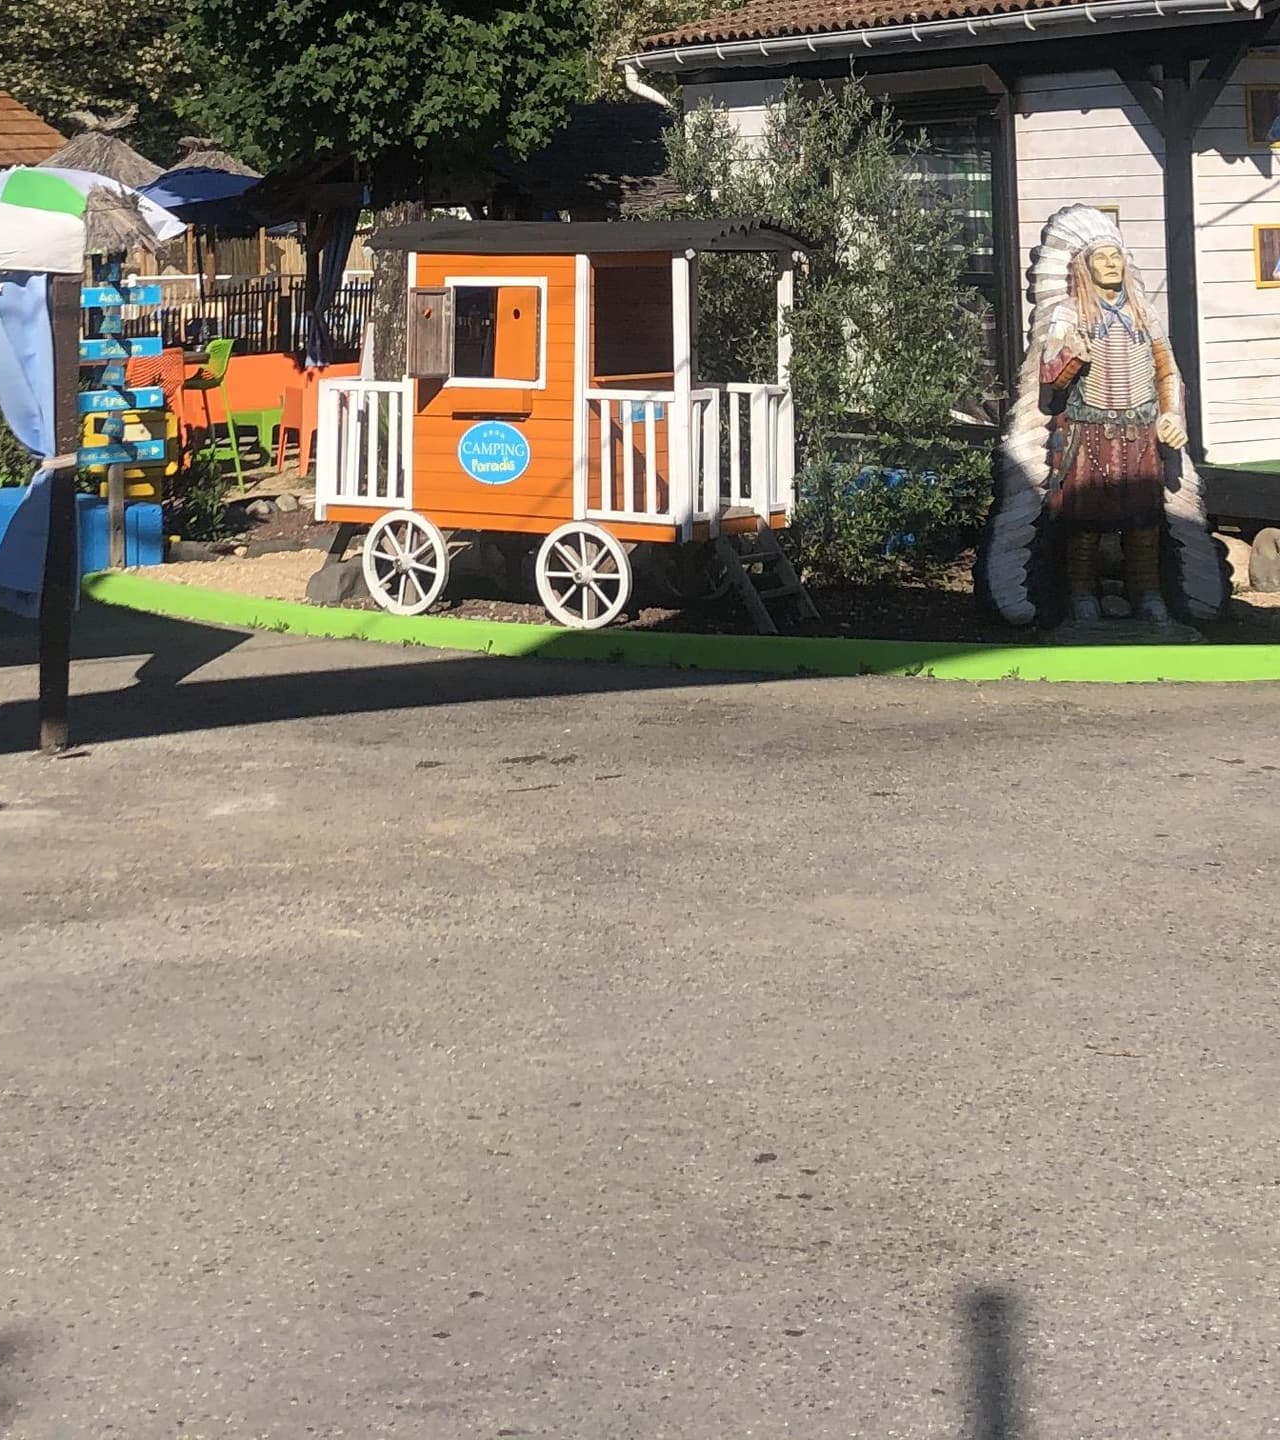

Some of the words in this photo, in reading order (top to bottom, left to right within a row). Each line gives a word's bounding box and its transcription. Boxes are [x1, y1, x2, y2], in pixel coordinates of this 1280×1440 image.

[98, 290, 145, 304] Acceil
[463, 441, 524, 457] CAMPING
[472, 458, 515, 472] Paradis
